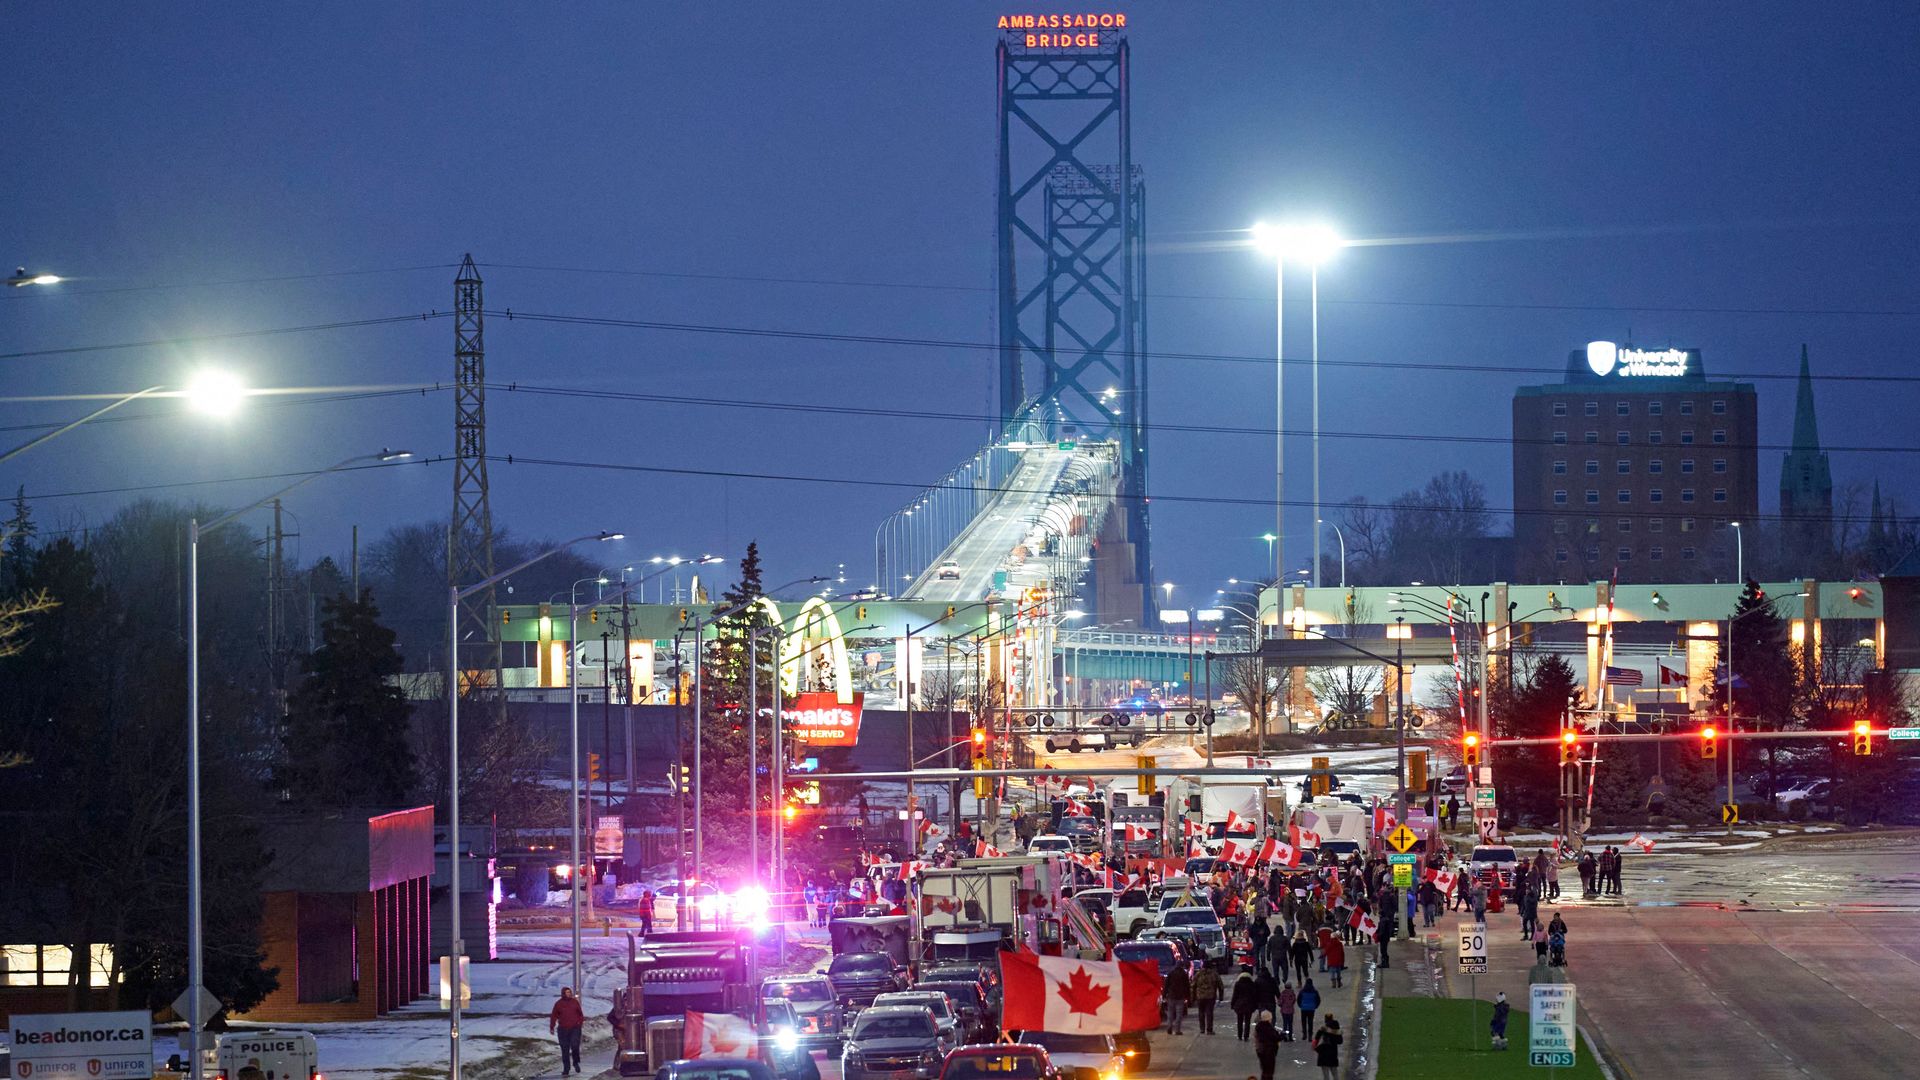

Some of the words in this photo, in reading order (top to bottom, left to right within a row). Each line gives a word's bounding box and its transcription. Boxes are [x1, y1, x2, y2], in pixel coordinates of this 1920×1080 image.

[998, 14, 1126, 28] AMBASSADOR
[1026, 34, 1099, 47] BRIDGE
[1618, 348, 1688, 366] University
[1618, 366, 1629, 376] of
[1629, 362, 1688, 376] Windsor
[809, 728, 845, 739] SERVED
[1462, 936, 1483, 950] 50
[1534, 989, 1572, 997] COMMUNITY
[1540, 1001, 1565, 1009] SAFETY
[1543, 1013, 1561, 1021] ZONE
[15, 1027, 144, 1044] beadonor.ca
[1543, 1027, 1562, 1035] FINES
[241, 1042, 295, 1053] POLICE
[1534, 1053, 1570, 1064] ENDS
